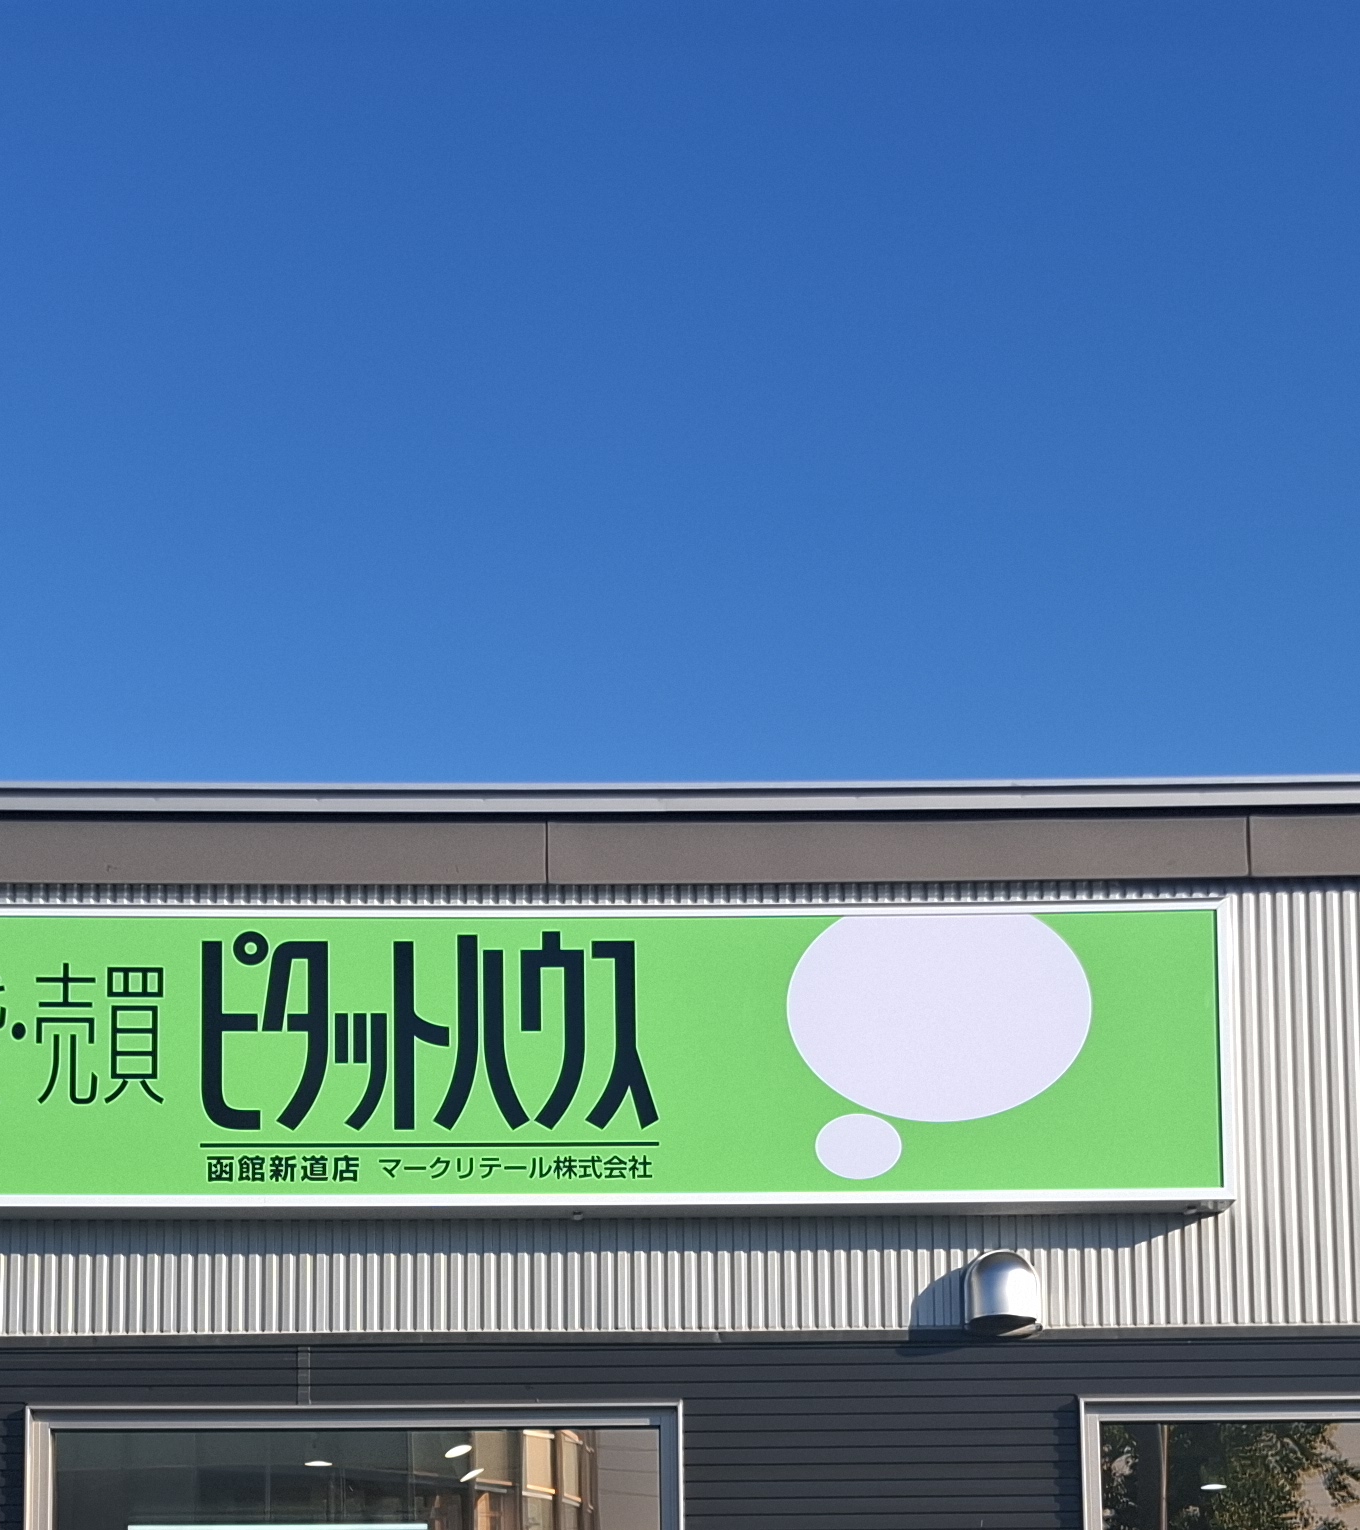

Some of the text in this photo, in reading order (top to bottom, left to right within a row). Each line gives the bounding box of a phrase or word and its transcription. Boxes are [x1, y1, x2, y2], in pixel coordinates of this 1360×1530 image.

[199, 930, 660, 1132] ピタットハウス
[206, 1155, 654, 1184] 函館新道店 マークリテール株式会社
